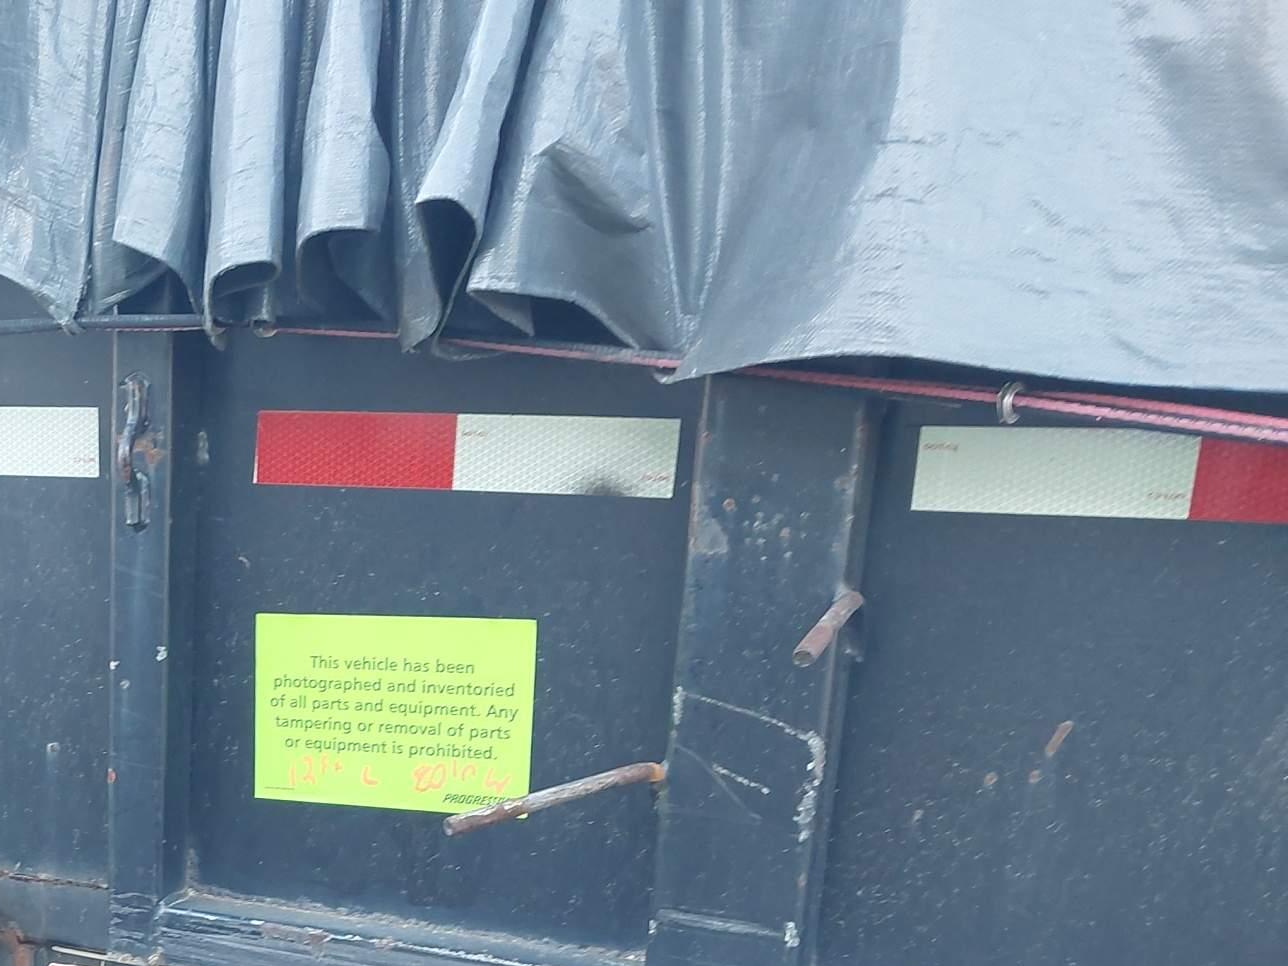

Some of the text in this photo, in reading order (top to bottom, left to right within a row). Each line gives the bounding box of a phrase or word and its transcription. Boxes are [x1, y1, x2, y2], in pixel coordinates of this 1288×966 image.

[311, 656, 474, 674] This vehicle has been
[273, 675, 515, 697] photographed and inventoried
[270, 695, 519, 722] of all parts and equipment. Any
[276, 716, 511, 741] tampering or removal of parts
[285, 737, 498, 760] or equipment is prohibited.
